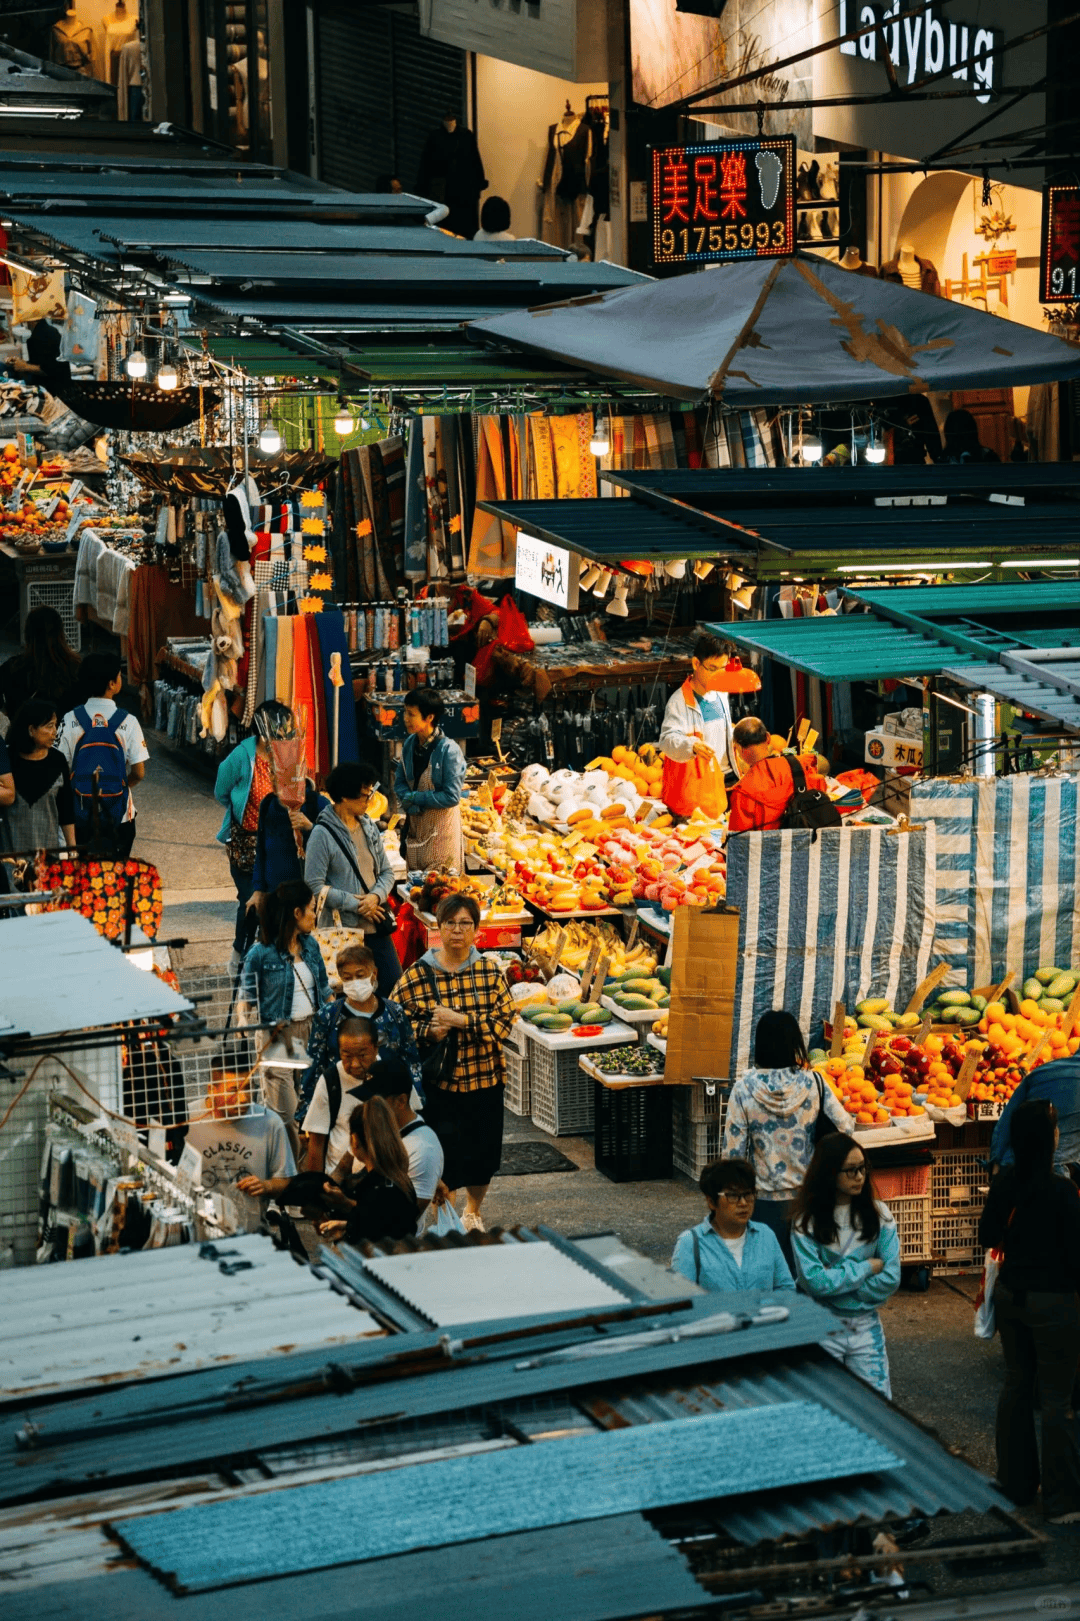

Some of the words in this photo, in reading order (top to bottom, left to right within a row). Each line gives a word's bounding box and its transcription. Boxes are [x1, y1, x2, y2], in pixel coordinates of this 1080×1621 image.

[839, 0, 994, 104] Ladybug
[662, 151, 747, 222] 美足樂
[661, 221, 785, 254] 91755993
[203, 1141, 253, 1160] CLASSIC
